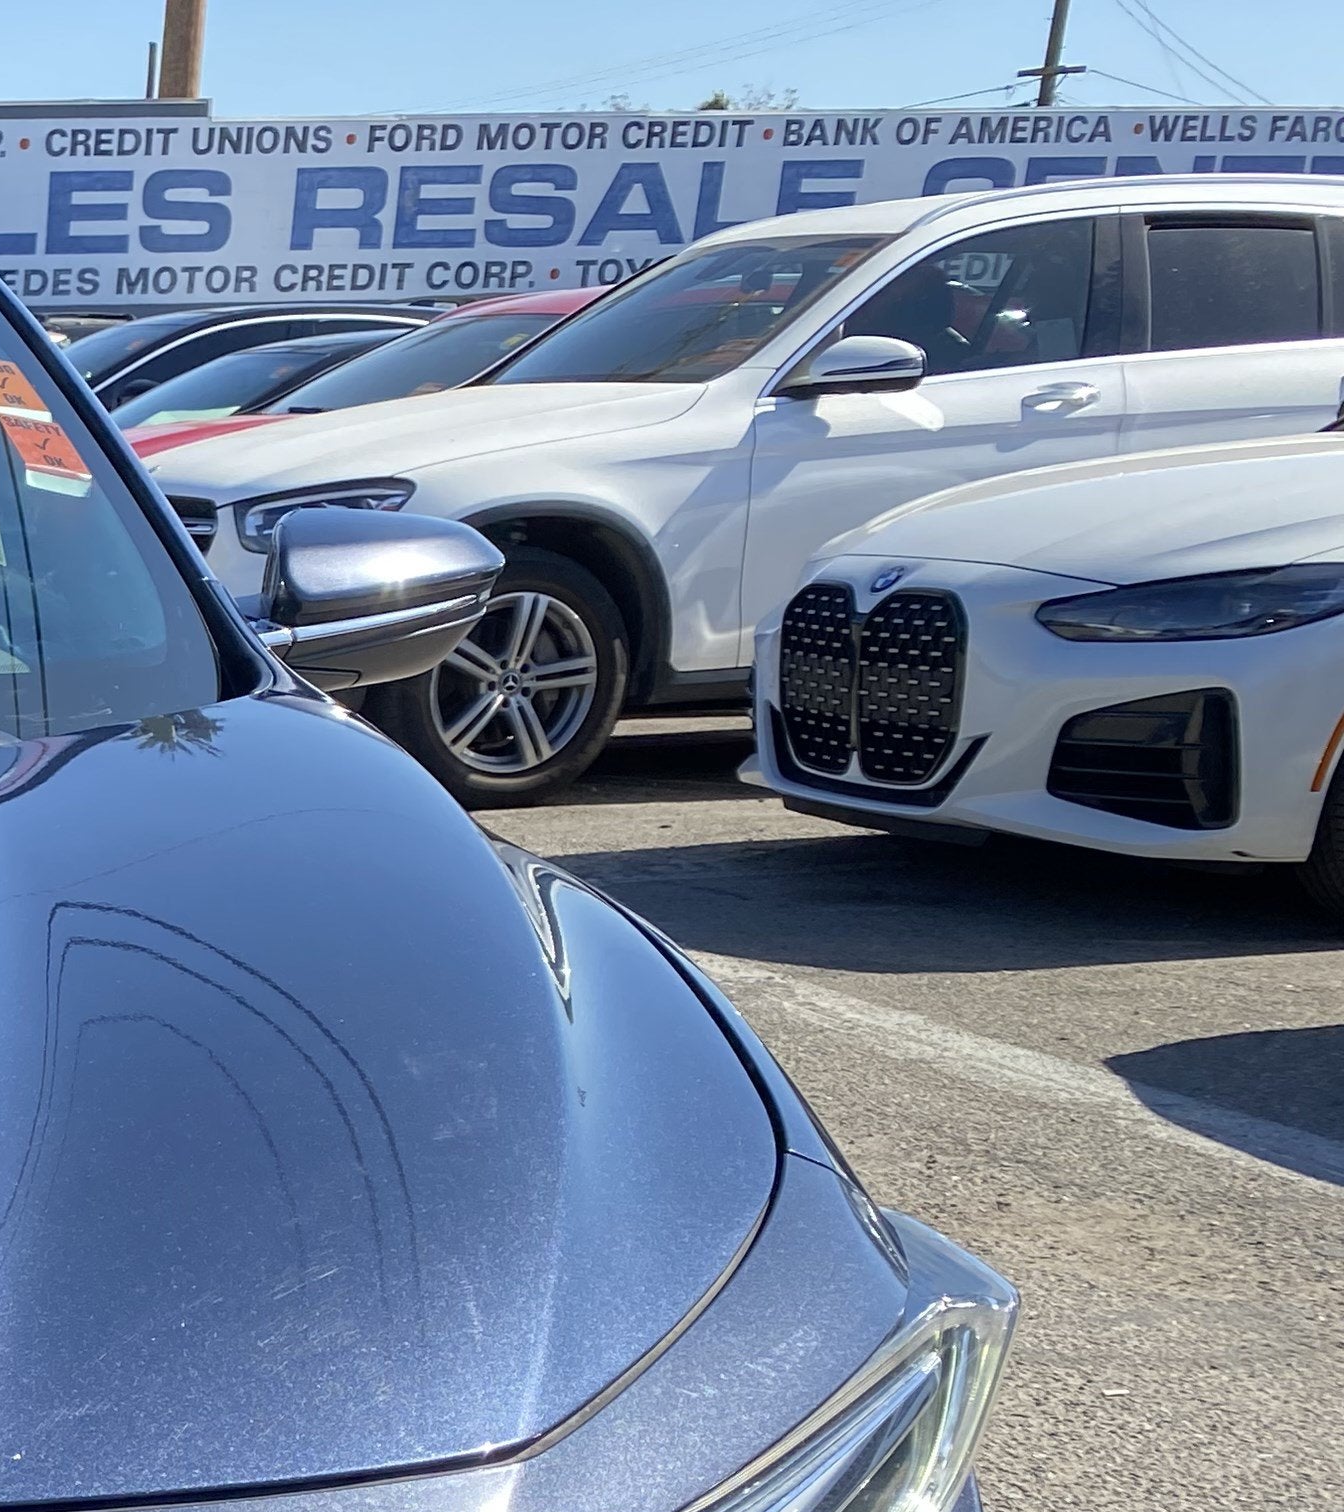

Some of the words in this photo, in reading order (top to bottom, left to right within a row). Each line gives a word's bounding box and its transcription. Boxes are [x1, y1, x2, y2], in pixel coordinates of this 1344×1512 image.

[45, 127, 179, 157] CREDIT
[192, 125, 332, 155] UNIONS
[367, 122, 463, 154] FORD
[477, 121, 609, 151] MOTOR
[621, 119, 755, 149] CREDIT
[782, 117, 884, 147] BANK
[895, 116, 941, 145] OF
[948, 115, 1112, 145] AMERICA
[1149, 115, 1257, 142] WELLS
[289, 158, 865, 251] RESALE
[116, 265, 257, 295] MOTOR
[273, 262, 414, 293] CREDIT
[426, 260, 536, 290] CORP.
[576, 258, 654, 288] TOY
[2, 416, 62, 436] SAFETY
